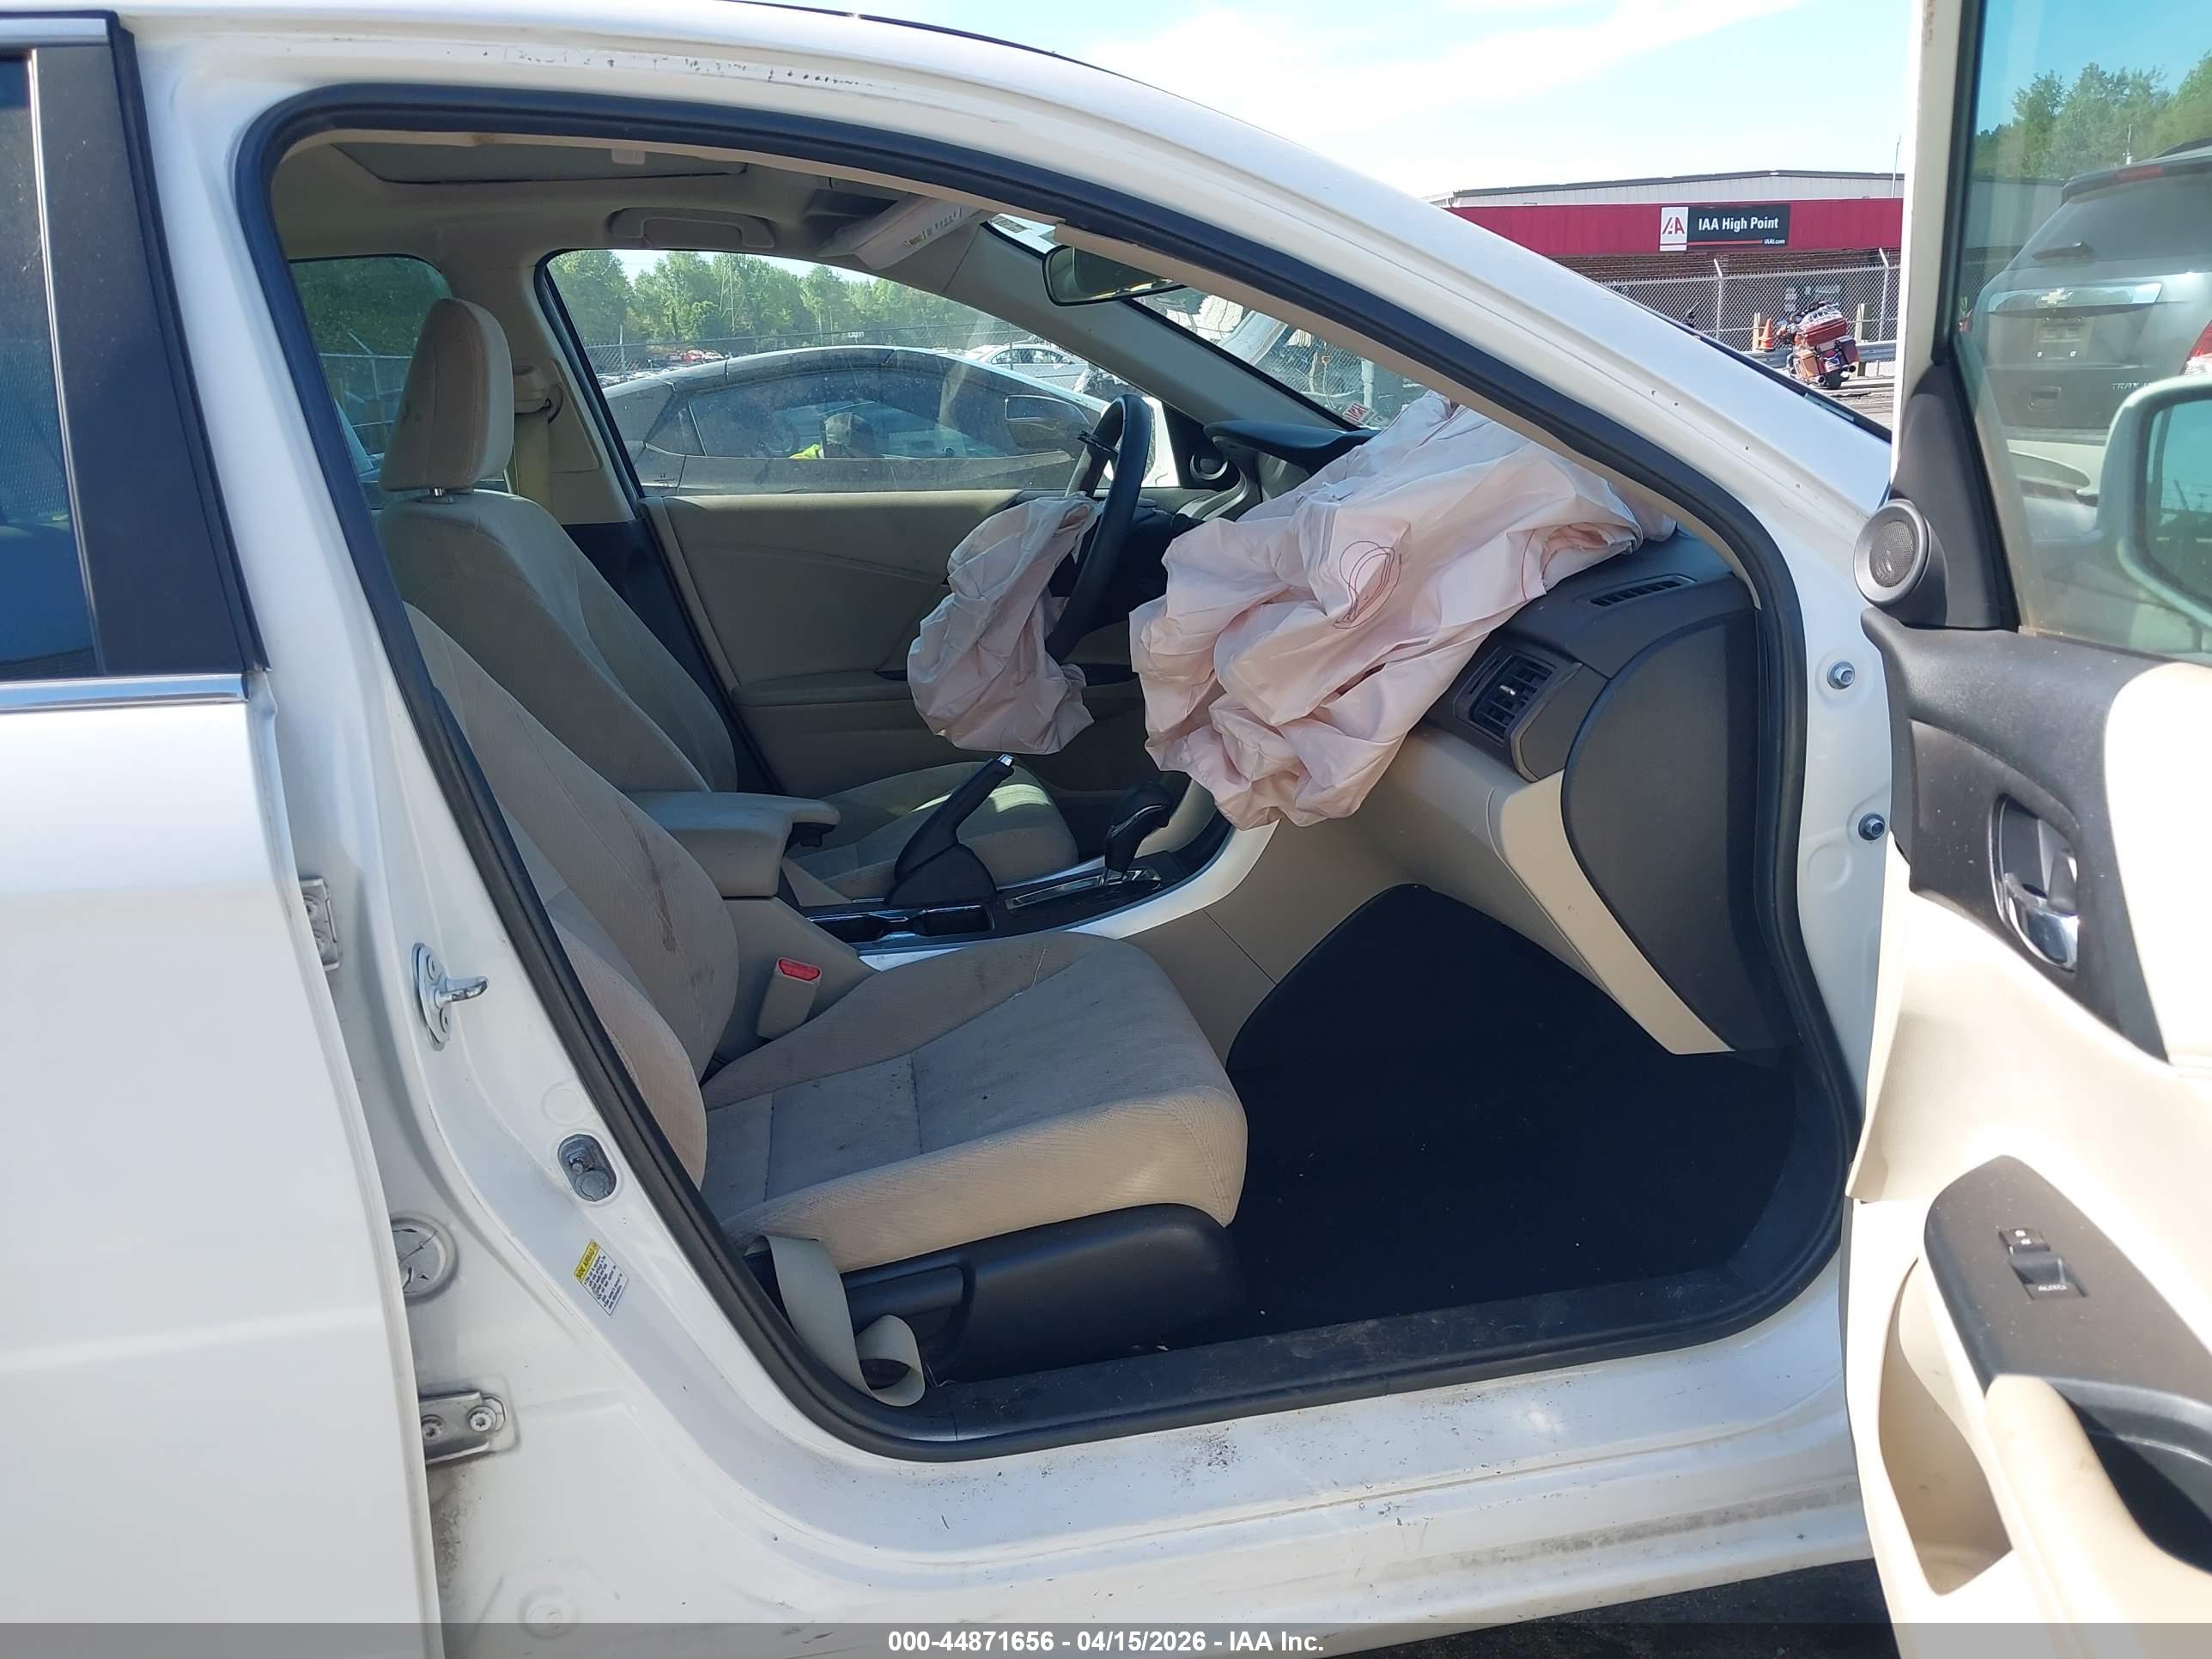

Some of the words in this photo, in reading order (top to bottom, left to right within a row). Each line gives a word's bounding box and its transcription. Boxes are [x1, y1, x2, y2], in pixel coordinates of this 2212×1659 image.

[1698, 217, 1719, 231] IAA
[1722, 216, 1747, 233] High
[1750, 216, 1779, 229] Point
